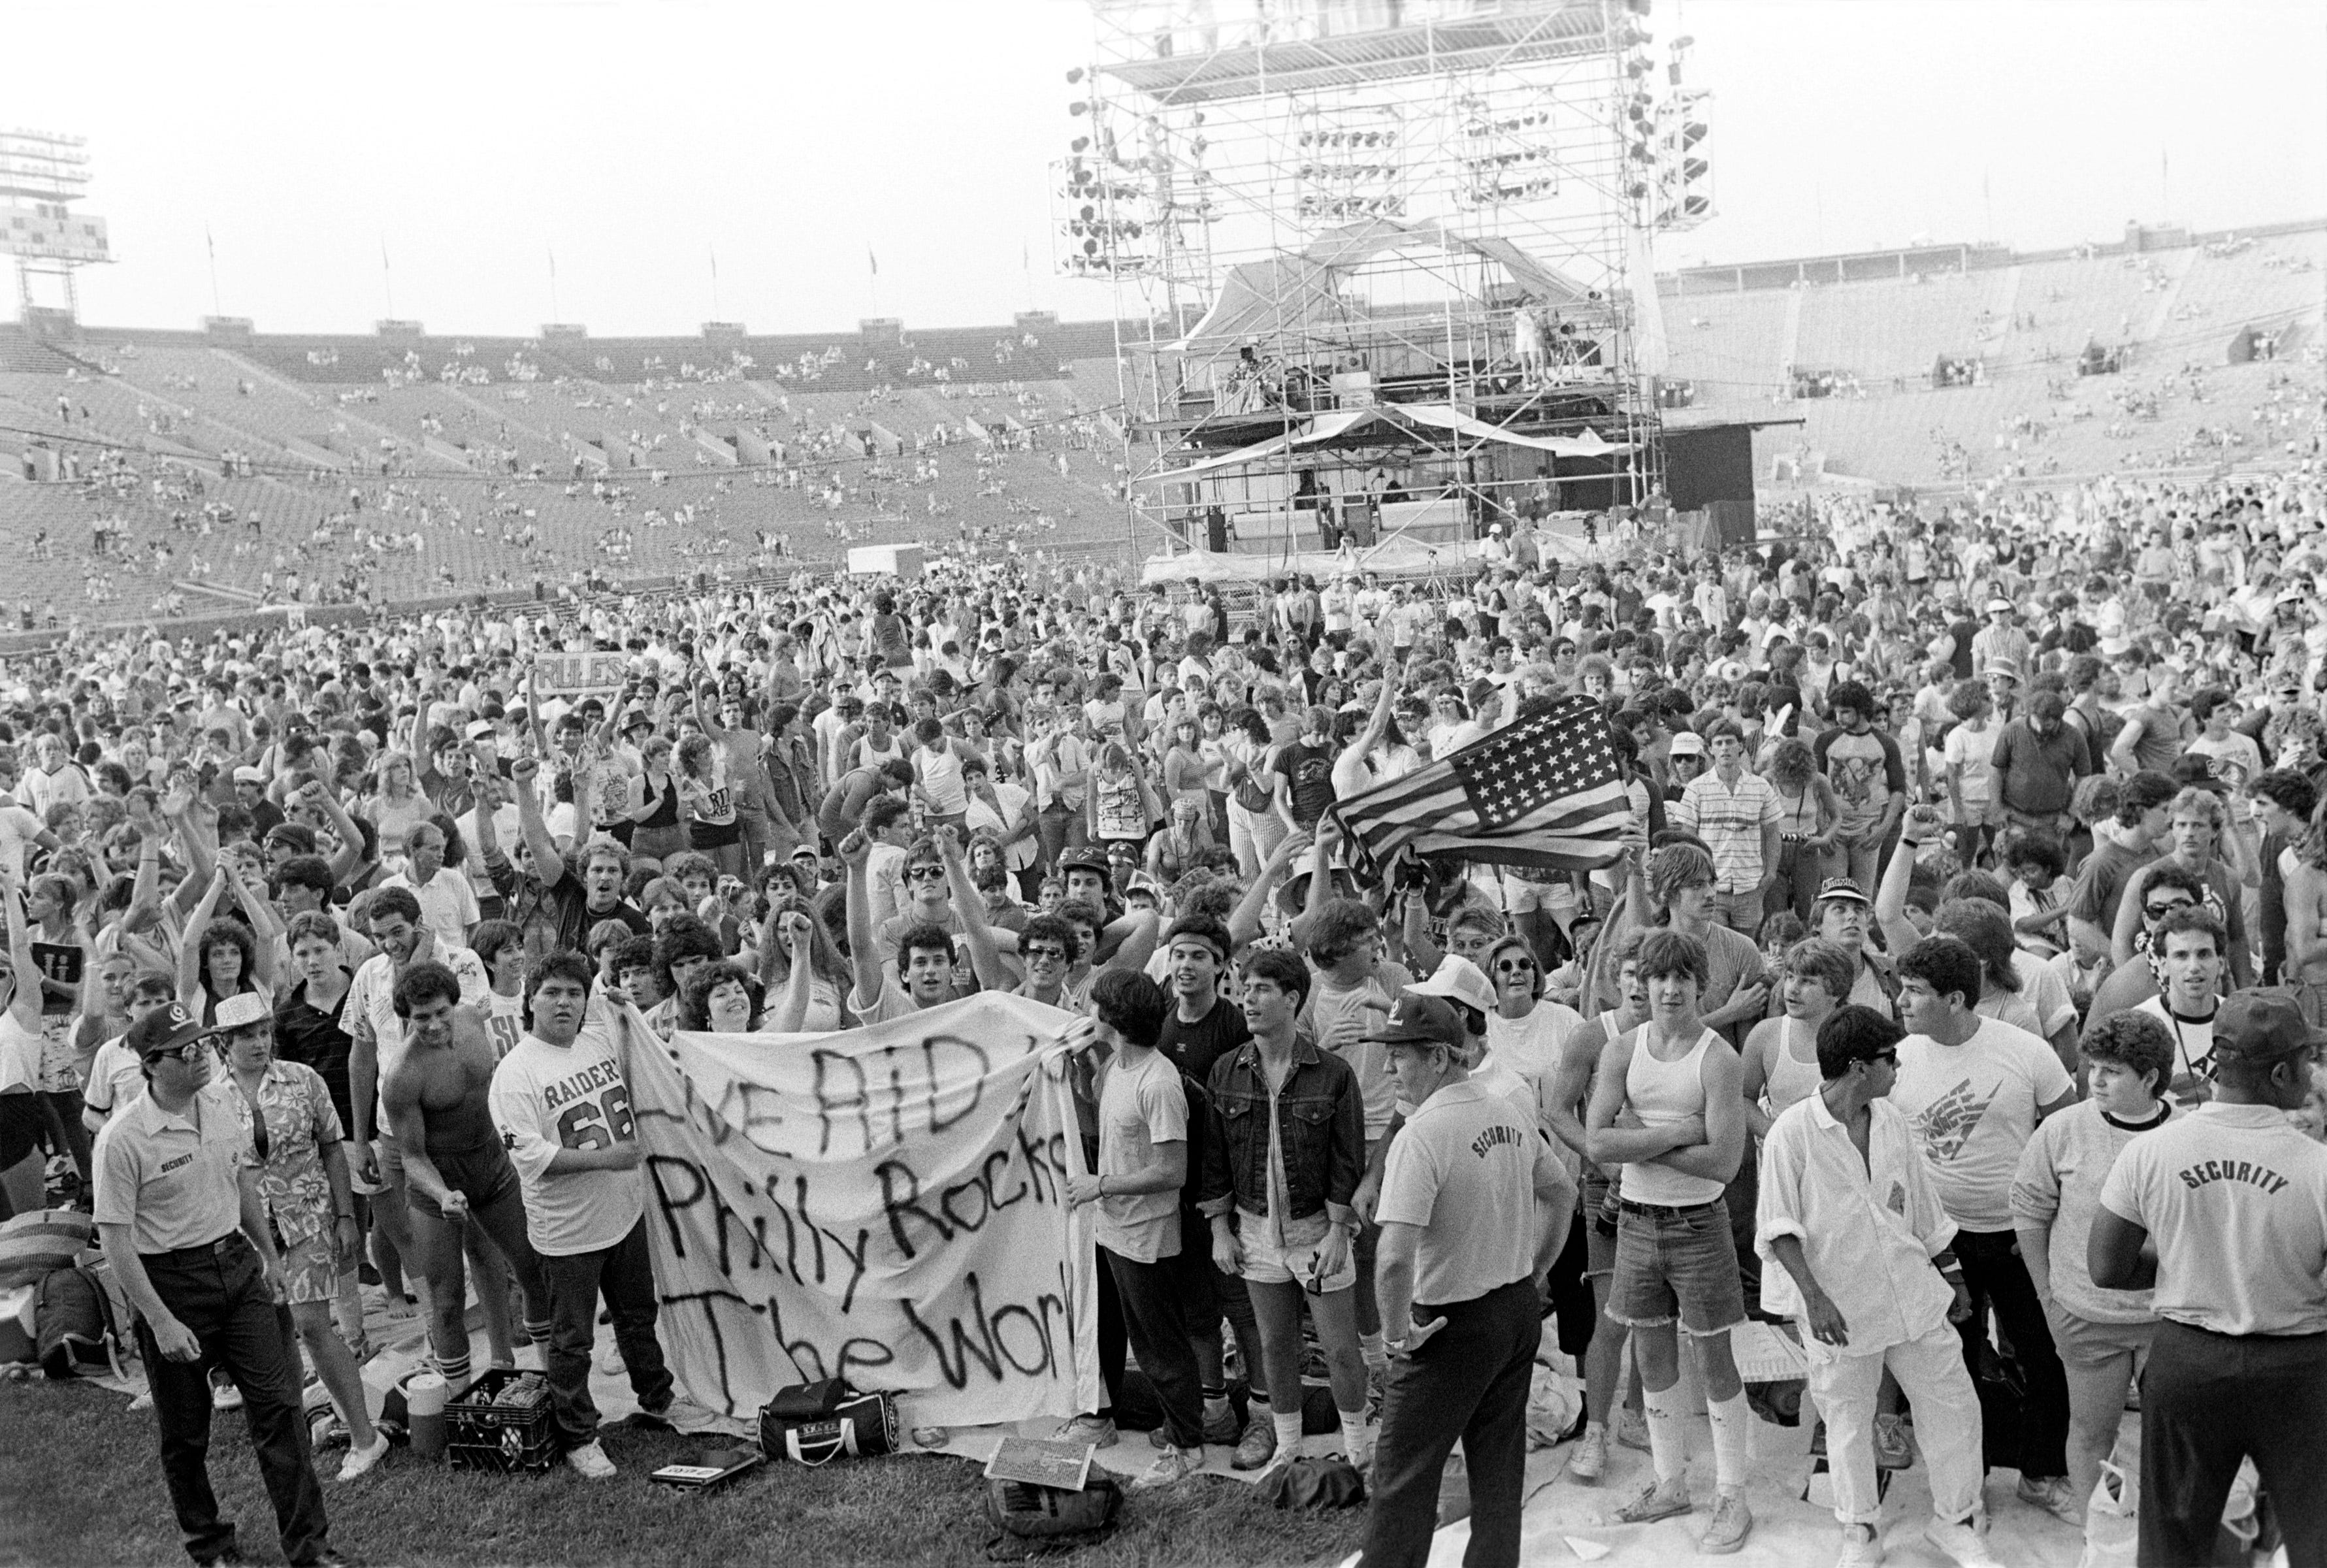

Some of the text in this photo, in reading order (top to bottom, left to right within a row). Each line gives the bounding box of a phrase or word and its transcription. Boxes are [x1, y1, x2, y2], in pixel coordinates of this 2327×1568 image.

[538, 657, 624, 689] RULES
[544, 1058, 620, 1111] RAIDER
[557, 1085, 638, 1150] 66
[161, 1152, 193, 1173] SECURITY
[1471, 1125, 1523, 1159] SECURITY
[2179, 1160, 2289, 1195] SECURITY
[646, 1153, 870, 1315] Philly
[662, 1260, 1076, 1417] The Worl
